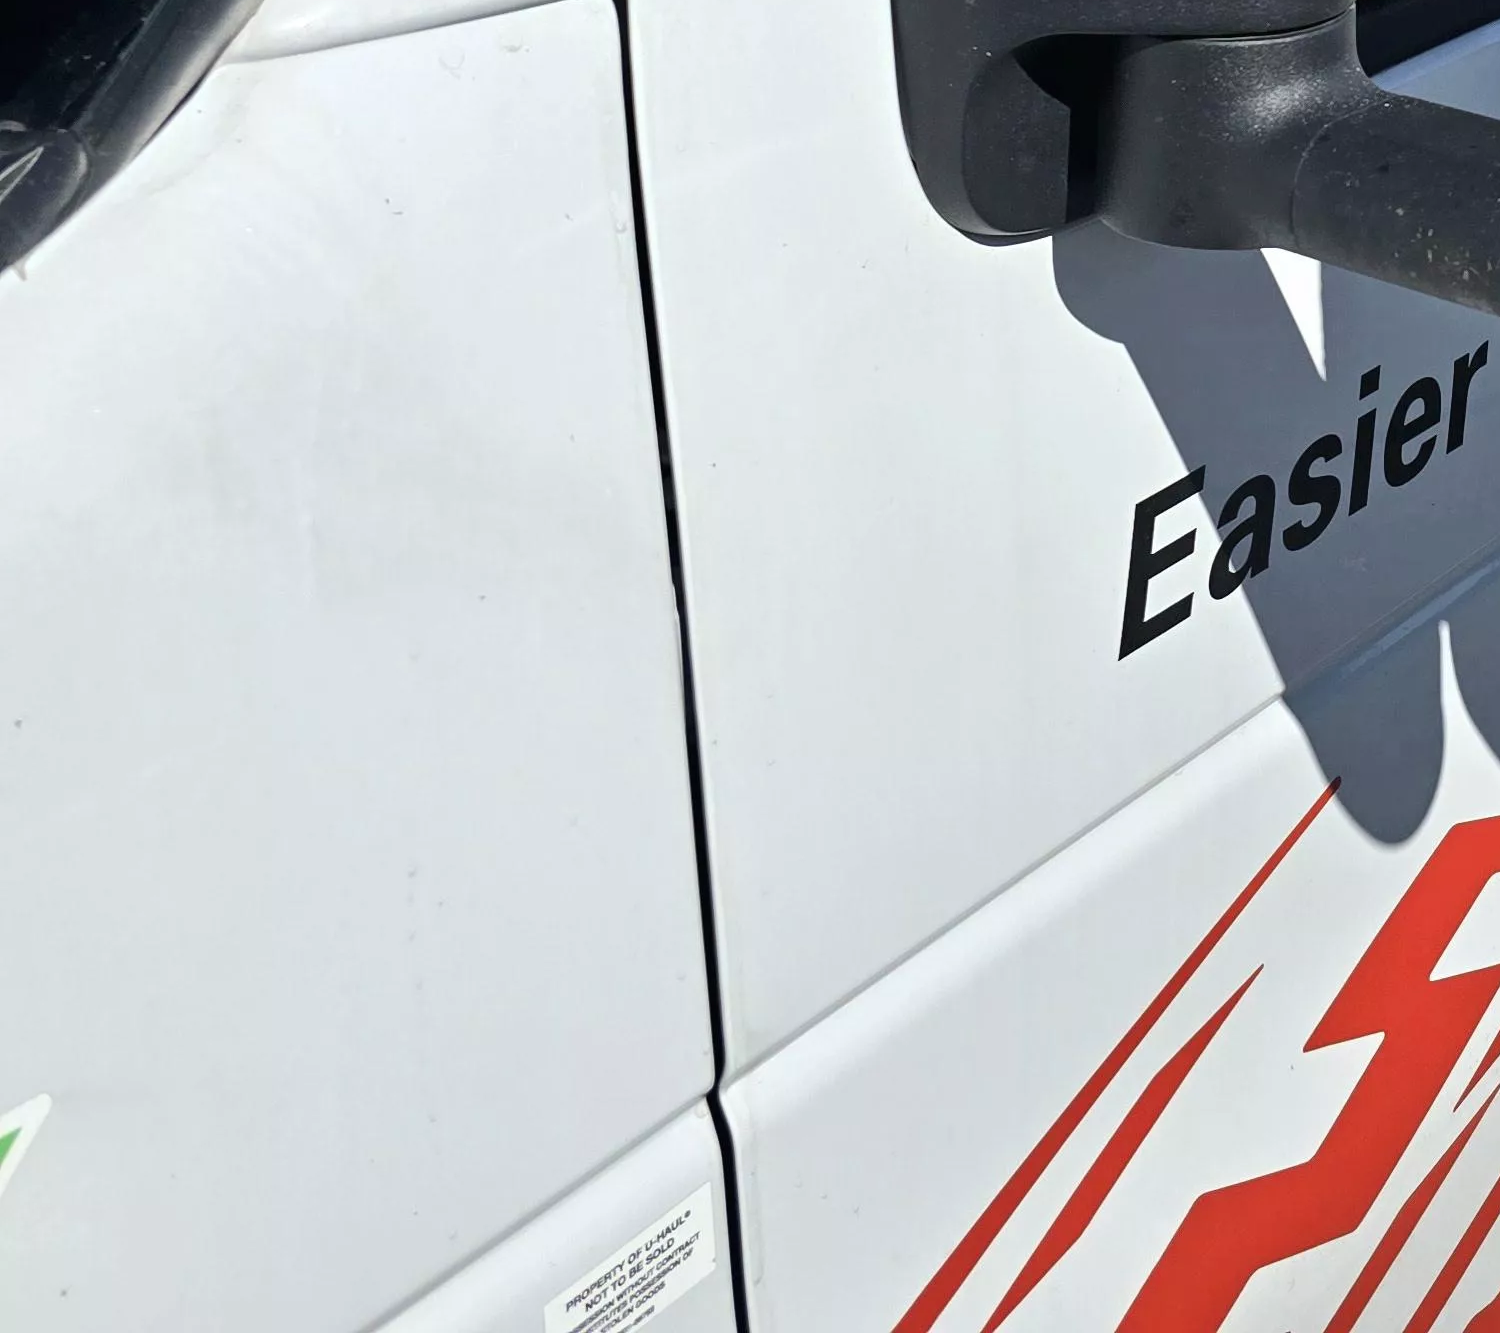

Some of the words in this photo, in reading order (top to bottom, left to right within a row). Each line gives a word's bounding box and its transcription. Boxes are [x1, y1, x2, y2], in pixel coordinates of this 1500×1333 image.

[1118, 340, 1491, 661] Easier
[566, 1260, 626, 1312] PROPERTY
[628, 1249, 643, 1265] OF
[585, 1288, 609, 1312] NOT
[611, 1275, 626, 1291] TO
[629, 1263, 644, 1279] BE
[645, 1237, 675, 1265] SOLD
[616, 1268, 655, 1301] WITHOUT
[656, 1231, 701, 1271] CONTRACT
[683, 1247, 694, 1262] OF
